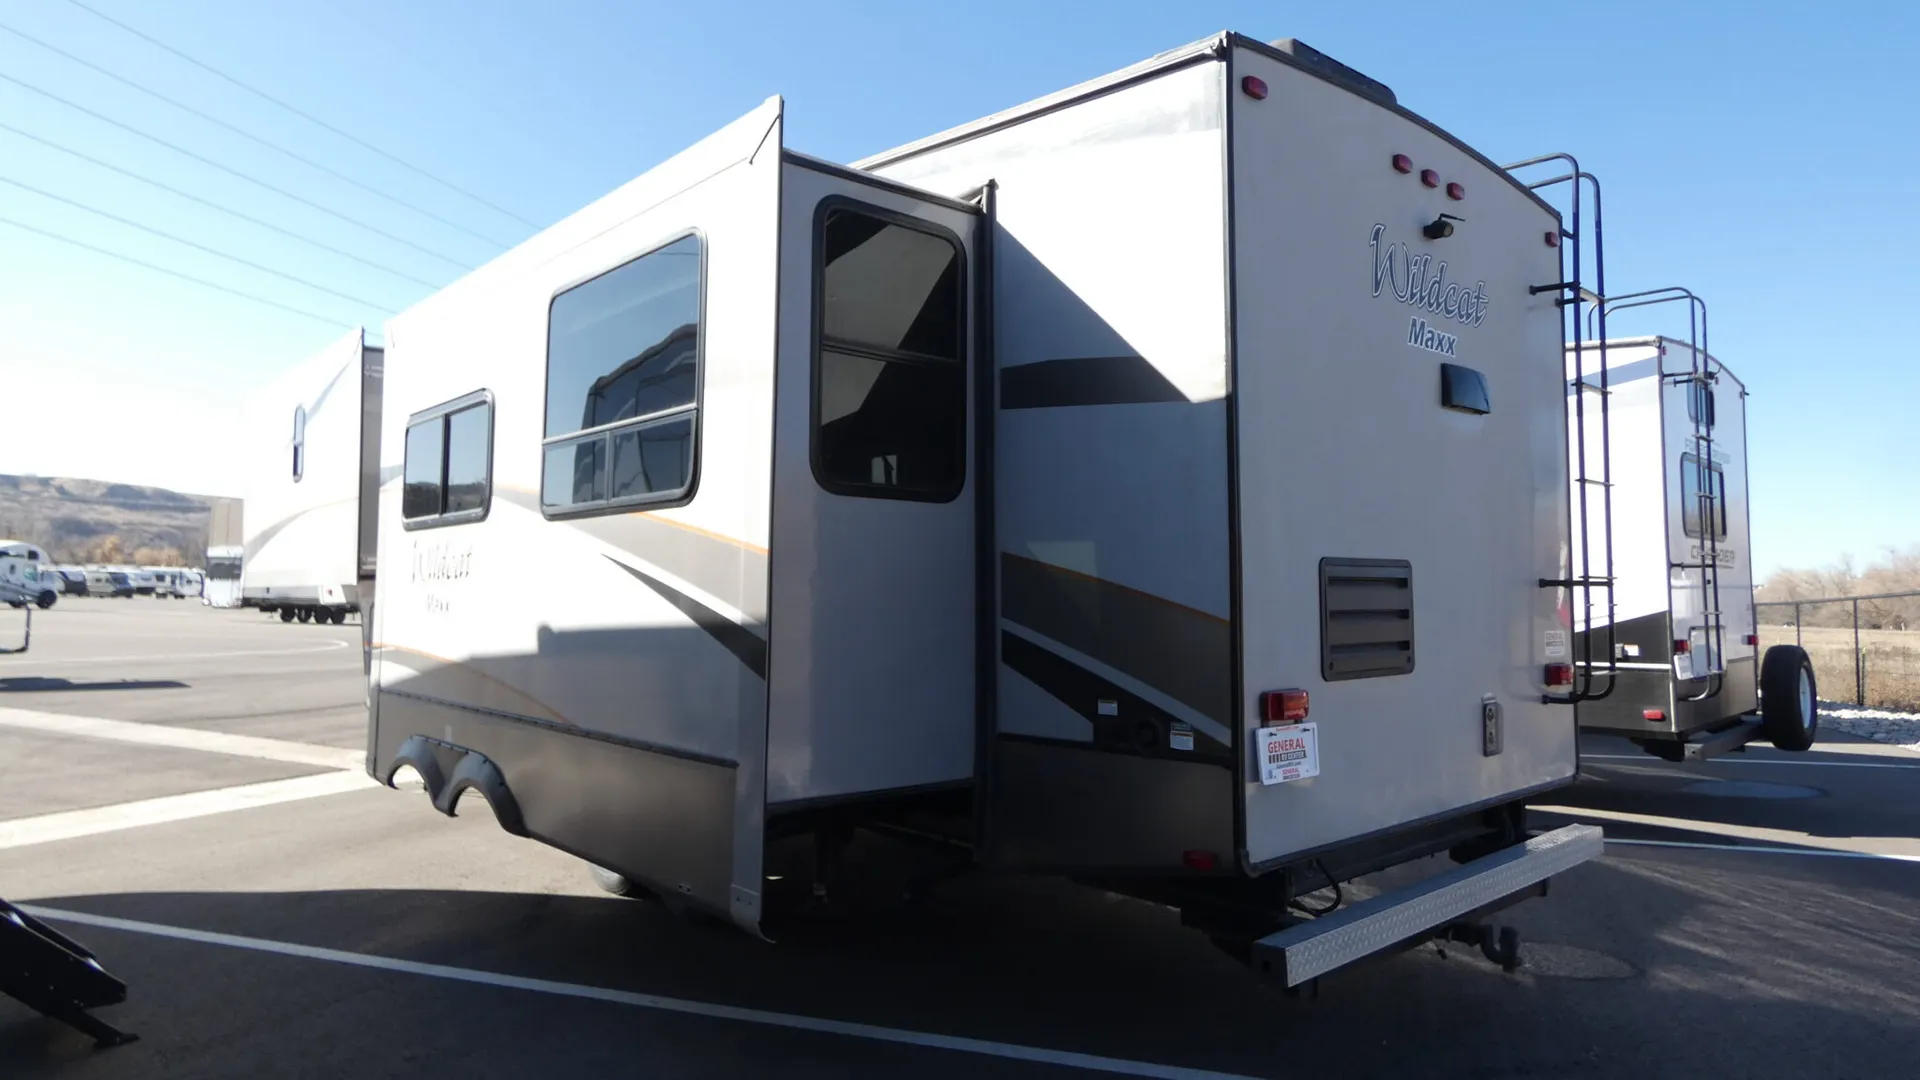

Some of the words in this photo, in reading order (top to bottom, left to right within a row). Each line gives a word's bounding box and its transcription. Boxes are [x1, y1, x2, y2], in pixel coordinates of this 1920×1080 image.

[1369, 223, 1489, 327] Wildcat
[1408, 316, 1457, 357] Maxx
[1268, 738, 1306, 753] GENERAL
